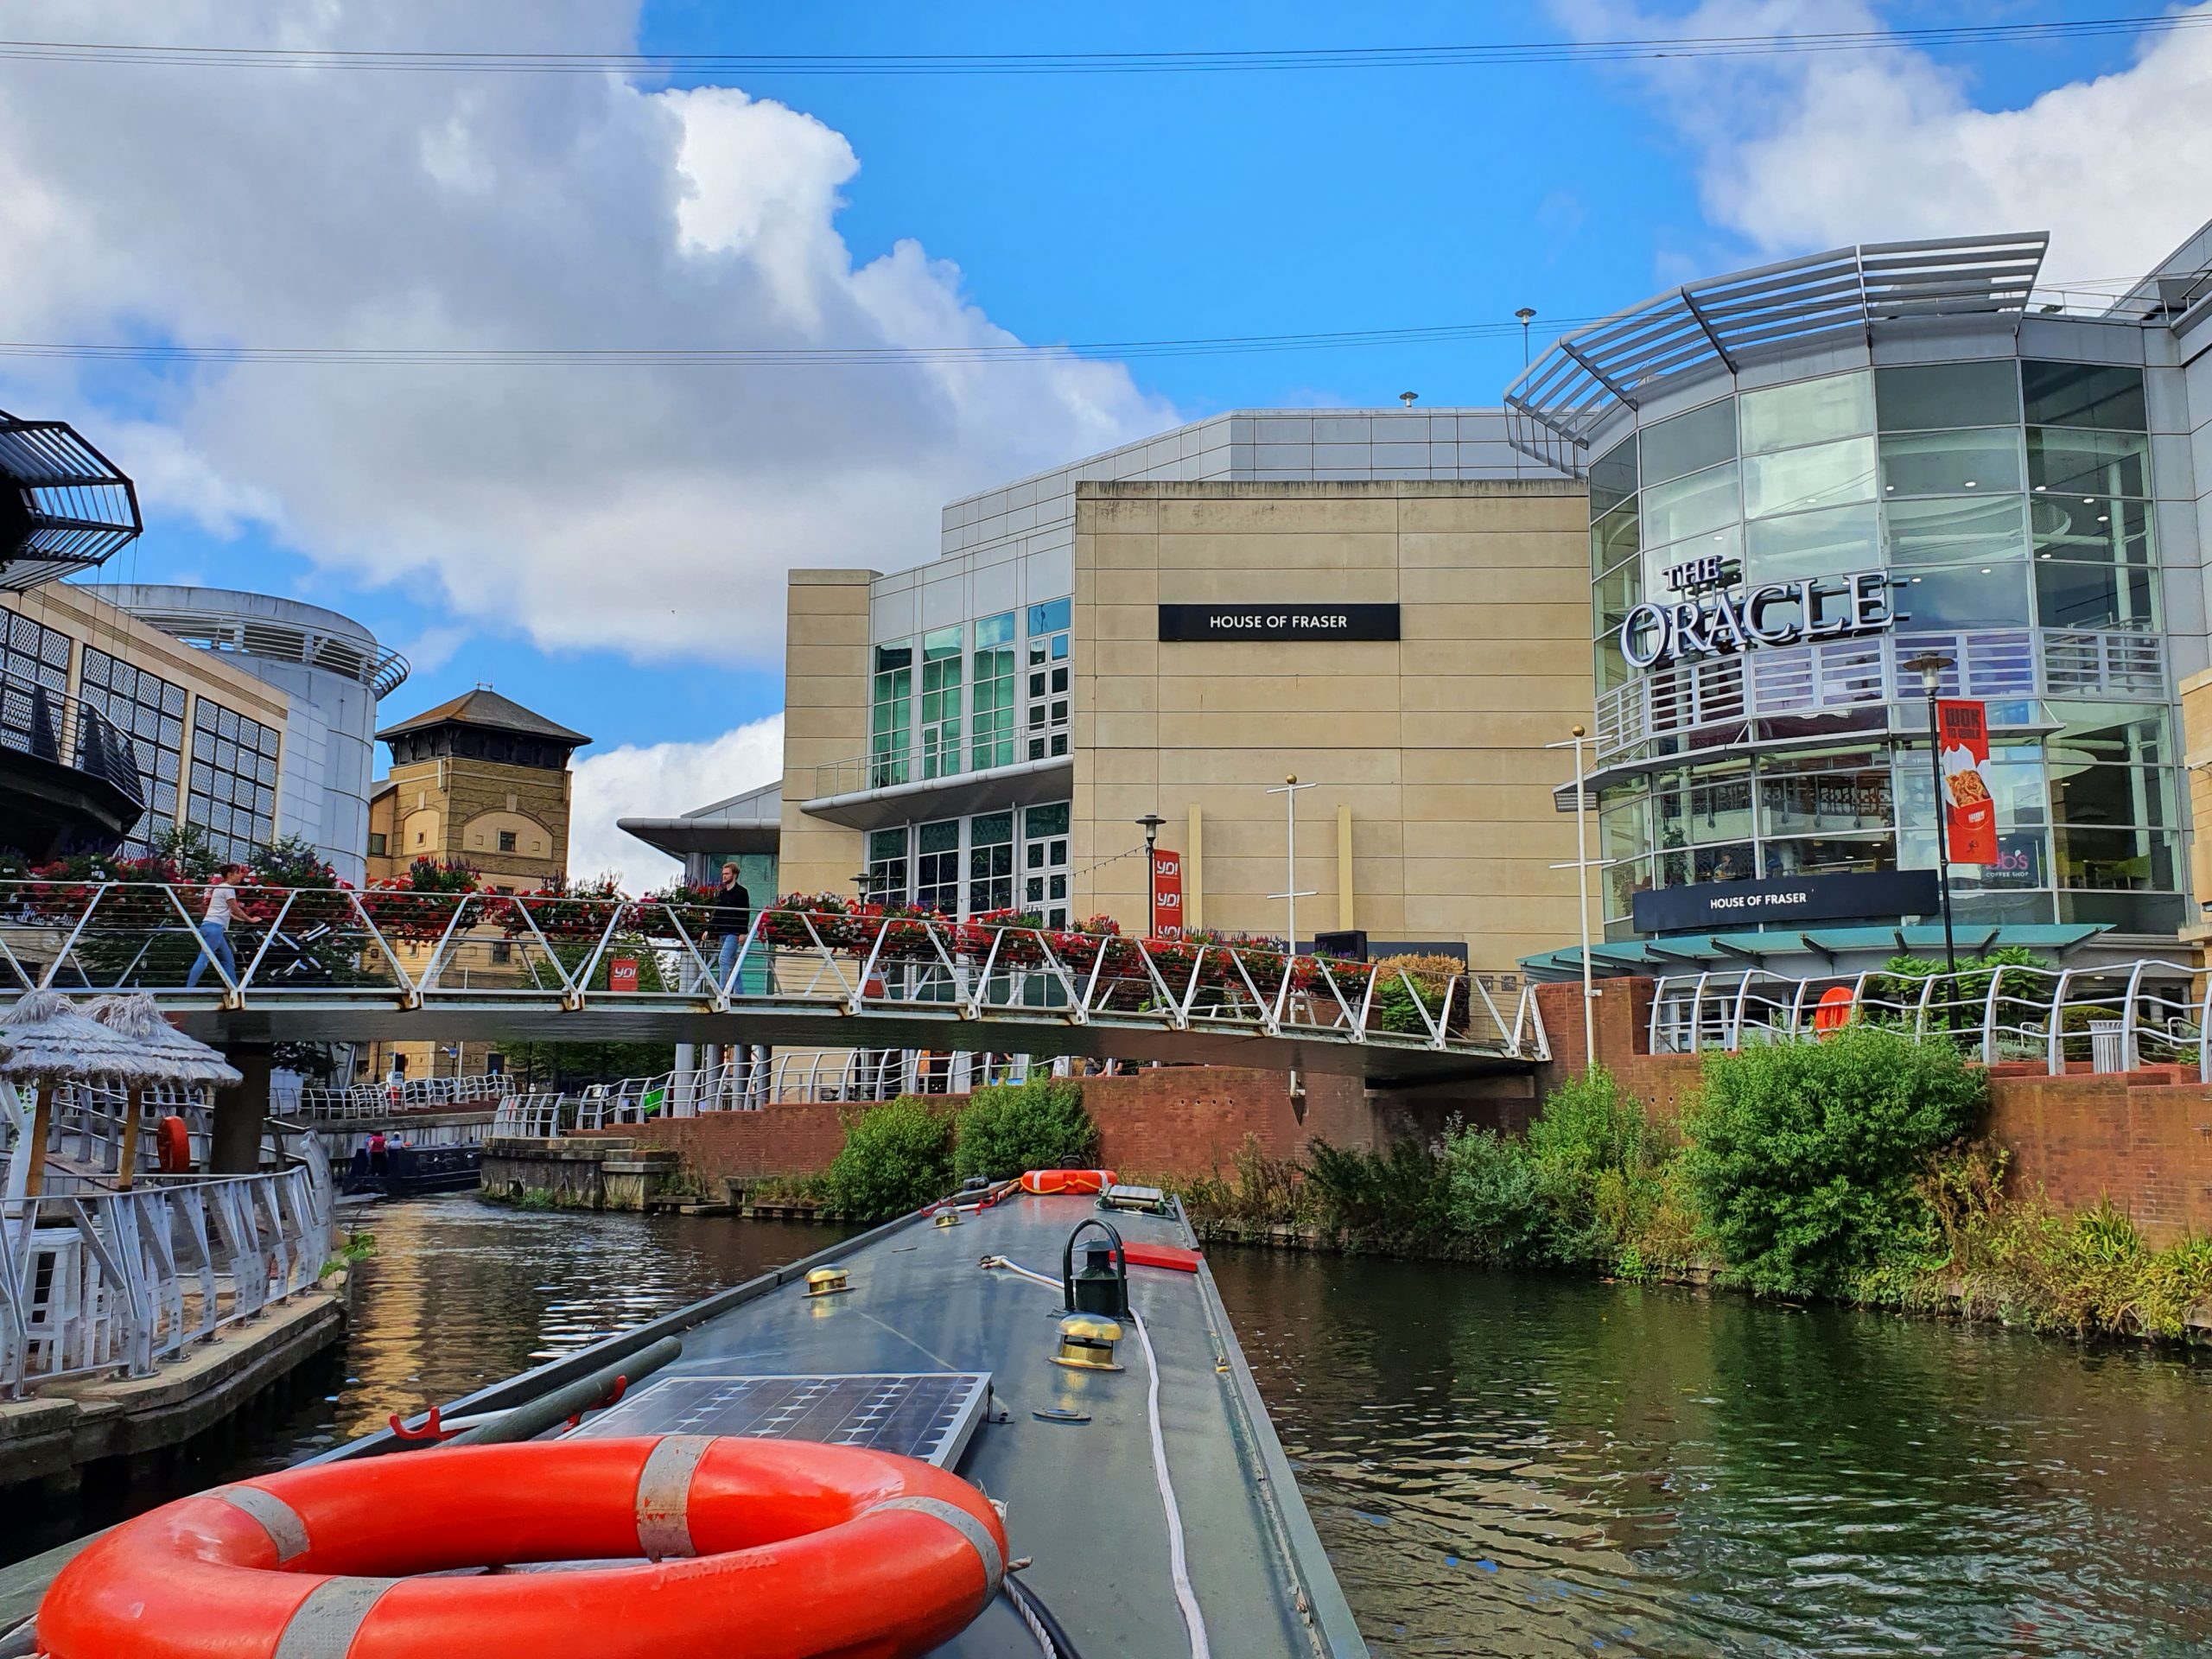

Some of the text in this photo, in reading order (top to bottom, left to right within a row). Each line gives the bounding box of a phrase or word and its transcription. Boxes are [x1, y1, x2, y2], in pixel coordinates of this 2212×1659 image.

[1662, 555, 1722, 592] THE
[1210, 615, 1347, 628] HOUSE OF FRASER
[1620, 570, 1895, 669] ORACLE
[1156, 860, 1179, 875] YO!
[1157, 892, 1180, 907] YO!
[1710, 893, 1807, 909] HOUSE OF FRASER
